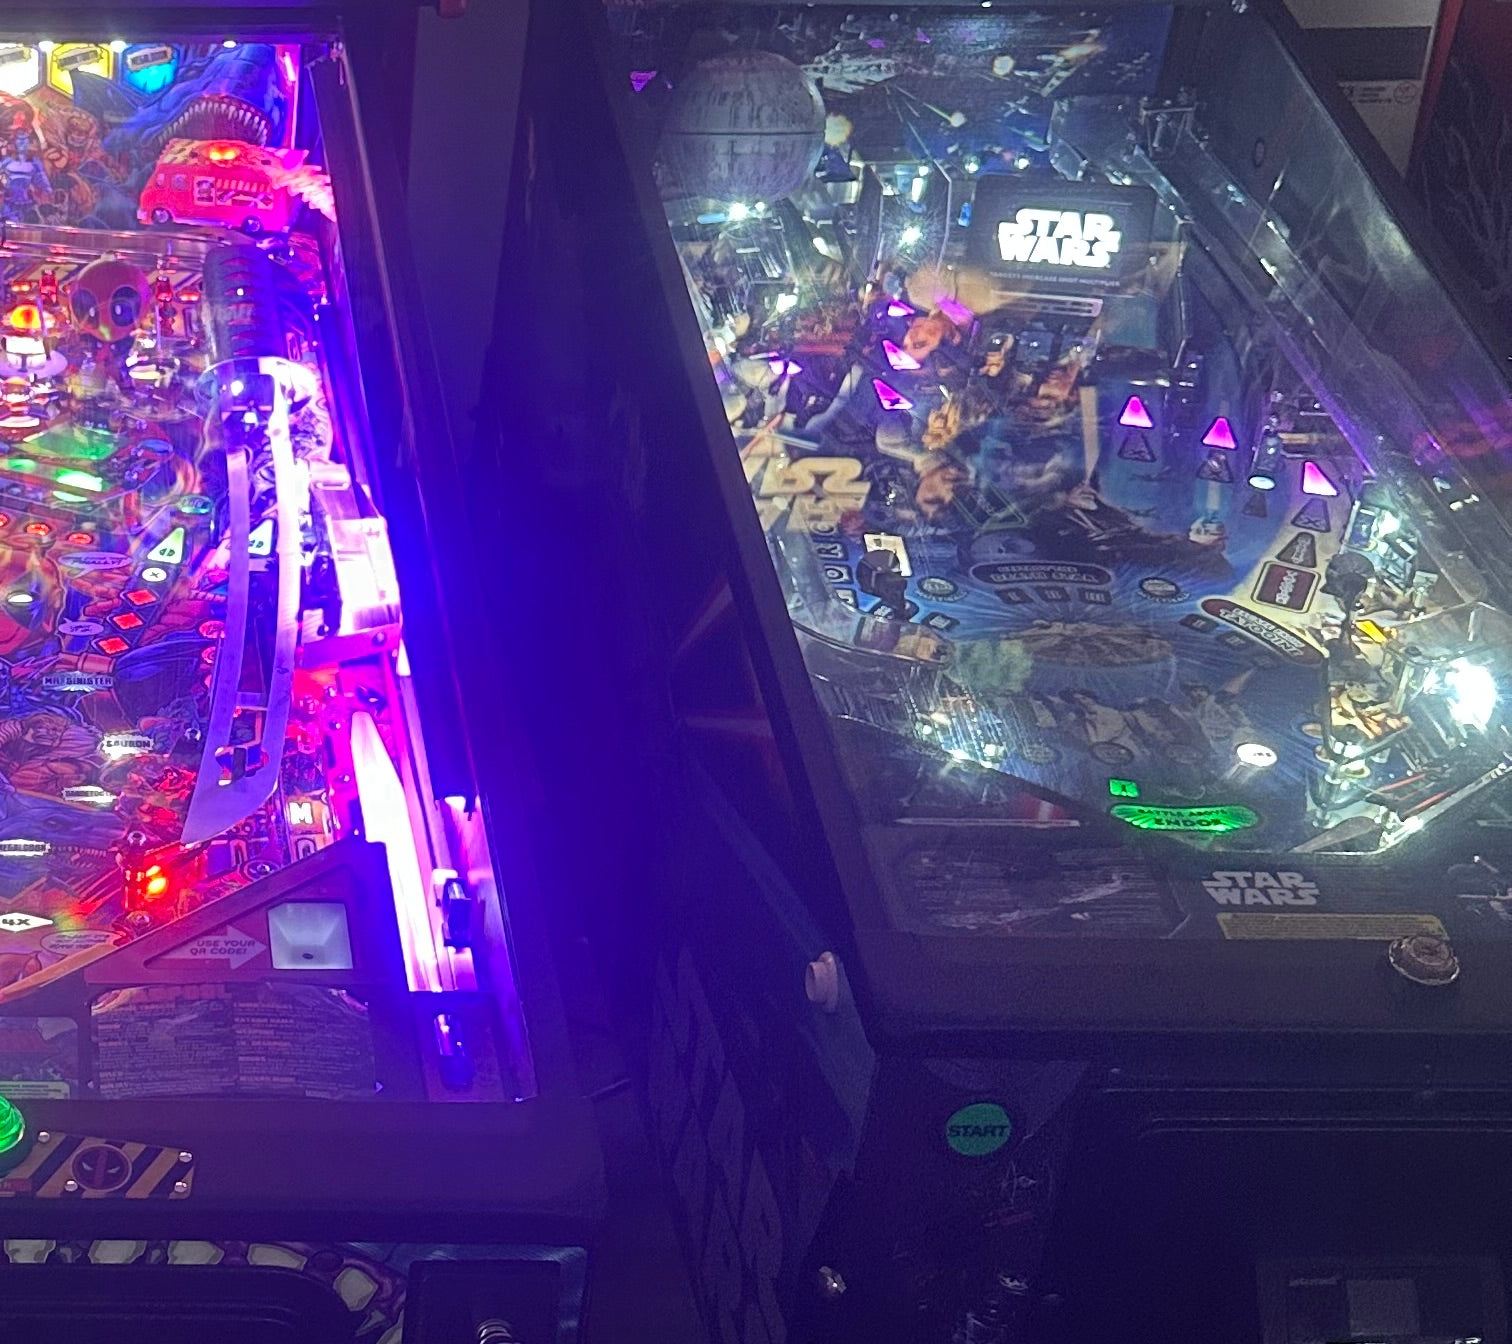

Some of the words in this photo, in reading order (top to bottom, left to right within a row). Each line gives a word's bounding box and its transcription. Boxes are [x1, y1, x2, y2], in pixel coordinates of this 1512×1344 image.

[999, 208, 1121, 241] STAR
[999, 236, 1119, 268] WARS
[1202, 870, 1317, 888] STAR
[1204, 887, 1320, 906] WARS
[1, 916, 31, 926] 4X
[947, 1123, 1011, 1139] START
